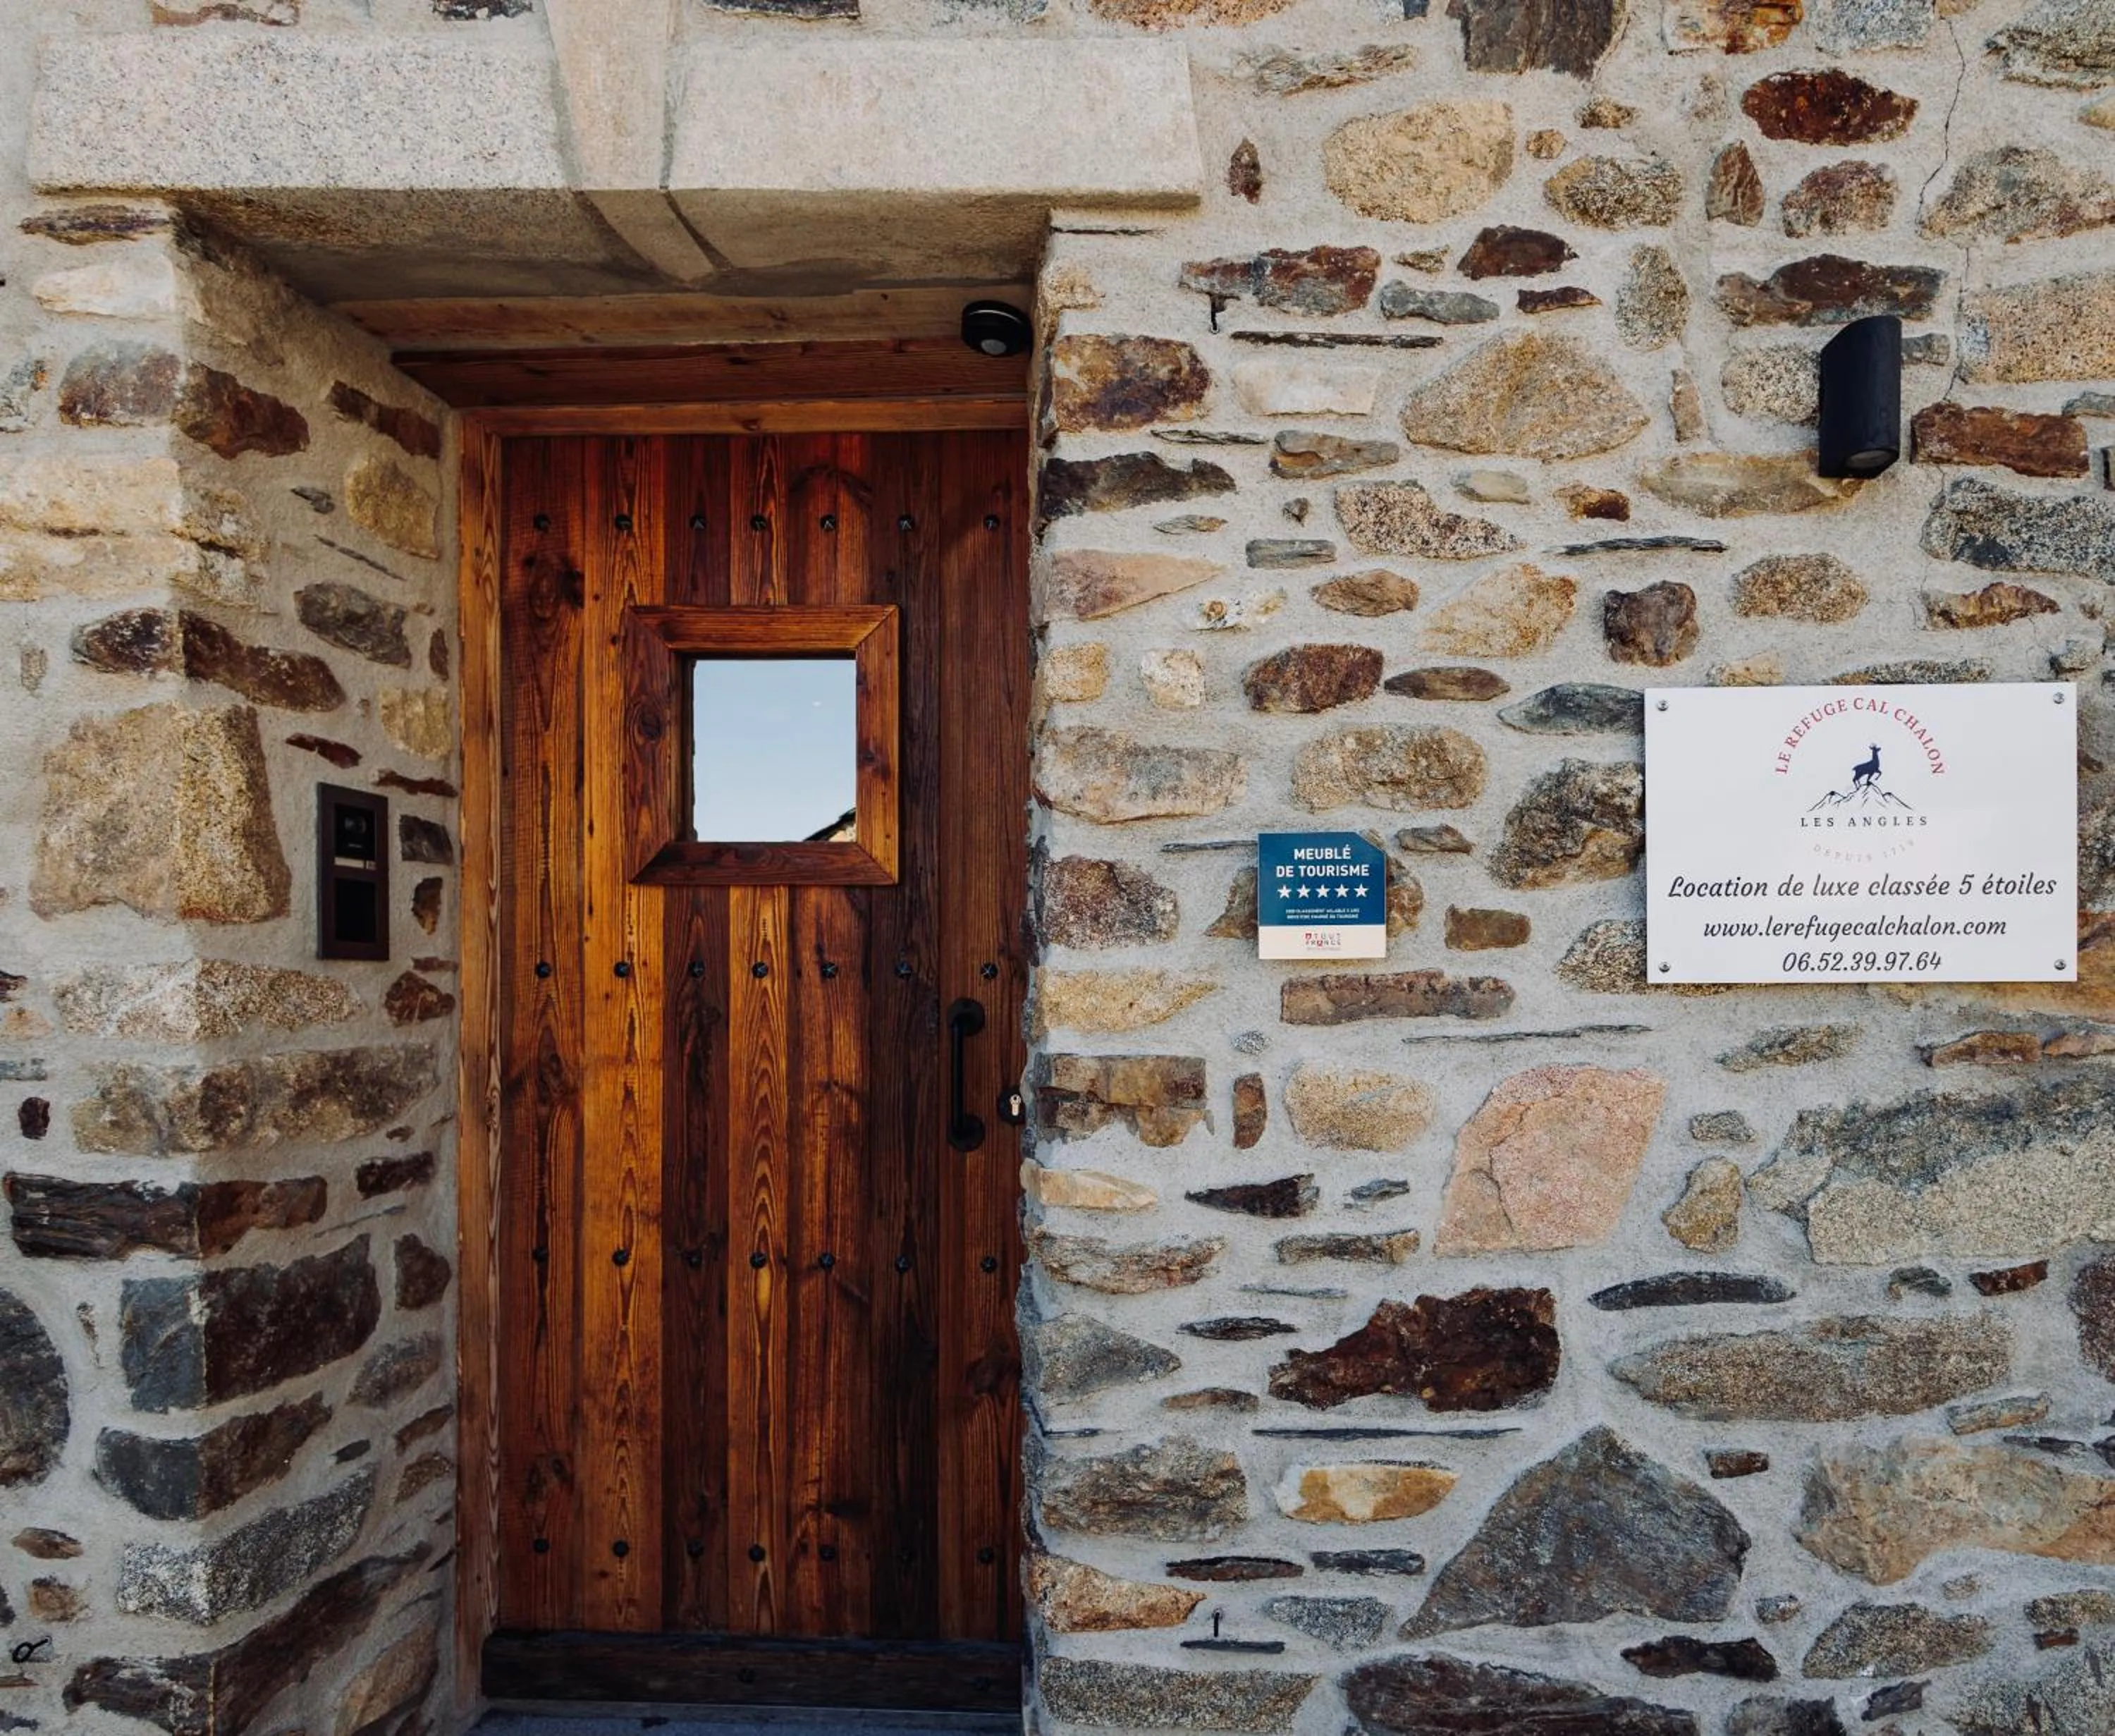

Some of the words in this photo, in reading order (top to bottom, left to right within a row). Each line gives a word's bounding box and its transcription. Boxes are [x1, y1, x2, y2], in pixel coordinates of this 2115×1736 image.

[1775, 750, 1791, 774] LE
[1784, 699, 1847, 749] REFUGE
[1853, 697, 1889, 714] CAL
[1894, 708, 1945, 774] CHALON
[1801, 817, 1834, 827] LES
[1848, 816, 1927, 827] ANGLES
[1294, 845, 1351, 860] MEUBLÉ
[1277, 866, 1294, 877] DE
[1299, 864, 1369, 876] TOURISME
[1668, 876, 1767, 898] Location
[1777, 874, 1804, 896] de
[1813, 874, 1859, 896] luxe
[1868, 873, 1950, 896] classée
[1958, 874, 1975, 895] 5
[1982, 872, 2056, 895] étoiles
[1704, 915, 2006, 943] www.lerefugecalchalon.com
[1782, 950, 1941, 972] 06.52.39.97.64
